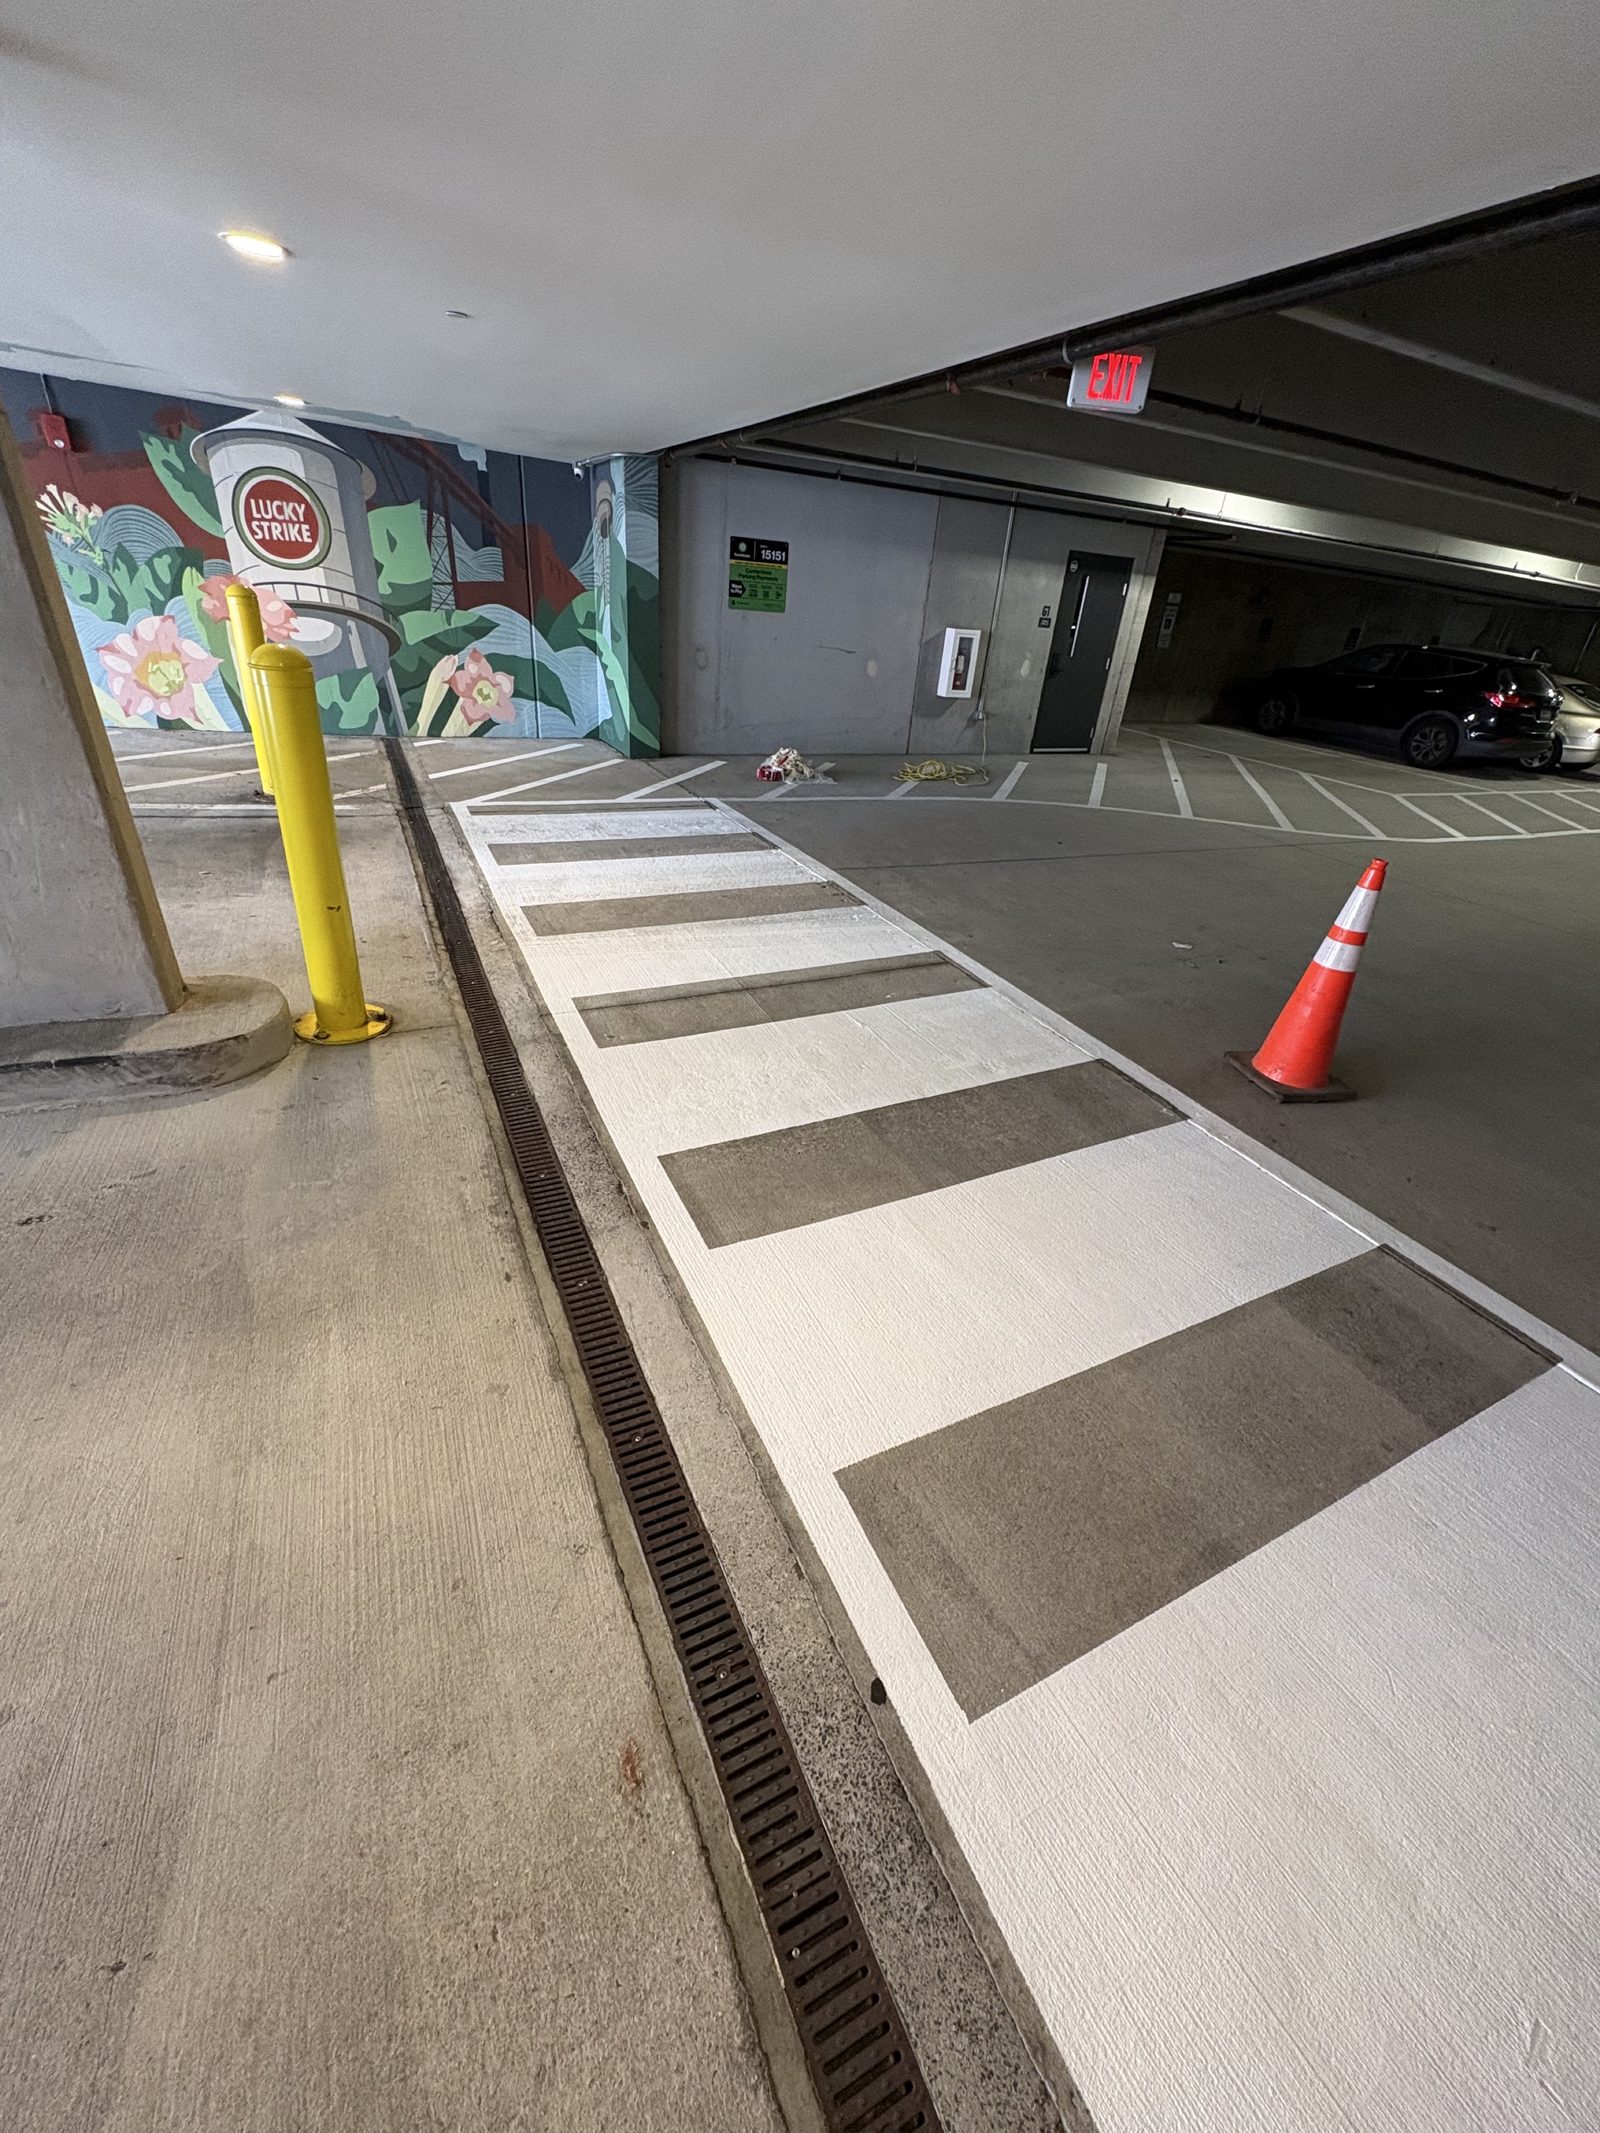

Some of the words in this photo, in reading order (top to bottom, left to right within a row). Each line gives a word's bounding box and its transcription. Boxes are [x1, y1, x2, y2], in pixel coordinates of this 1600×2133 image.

[1087, 353, 1142, 403] EXIT
[249, 498, 306, 522] LUCKY
[251, 520, 313, 543] STRIKE
[761, 549, 786, 561] 15151
